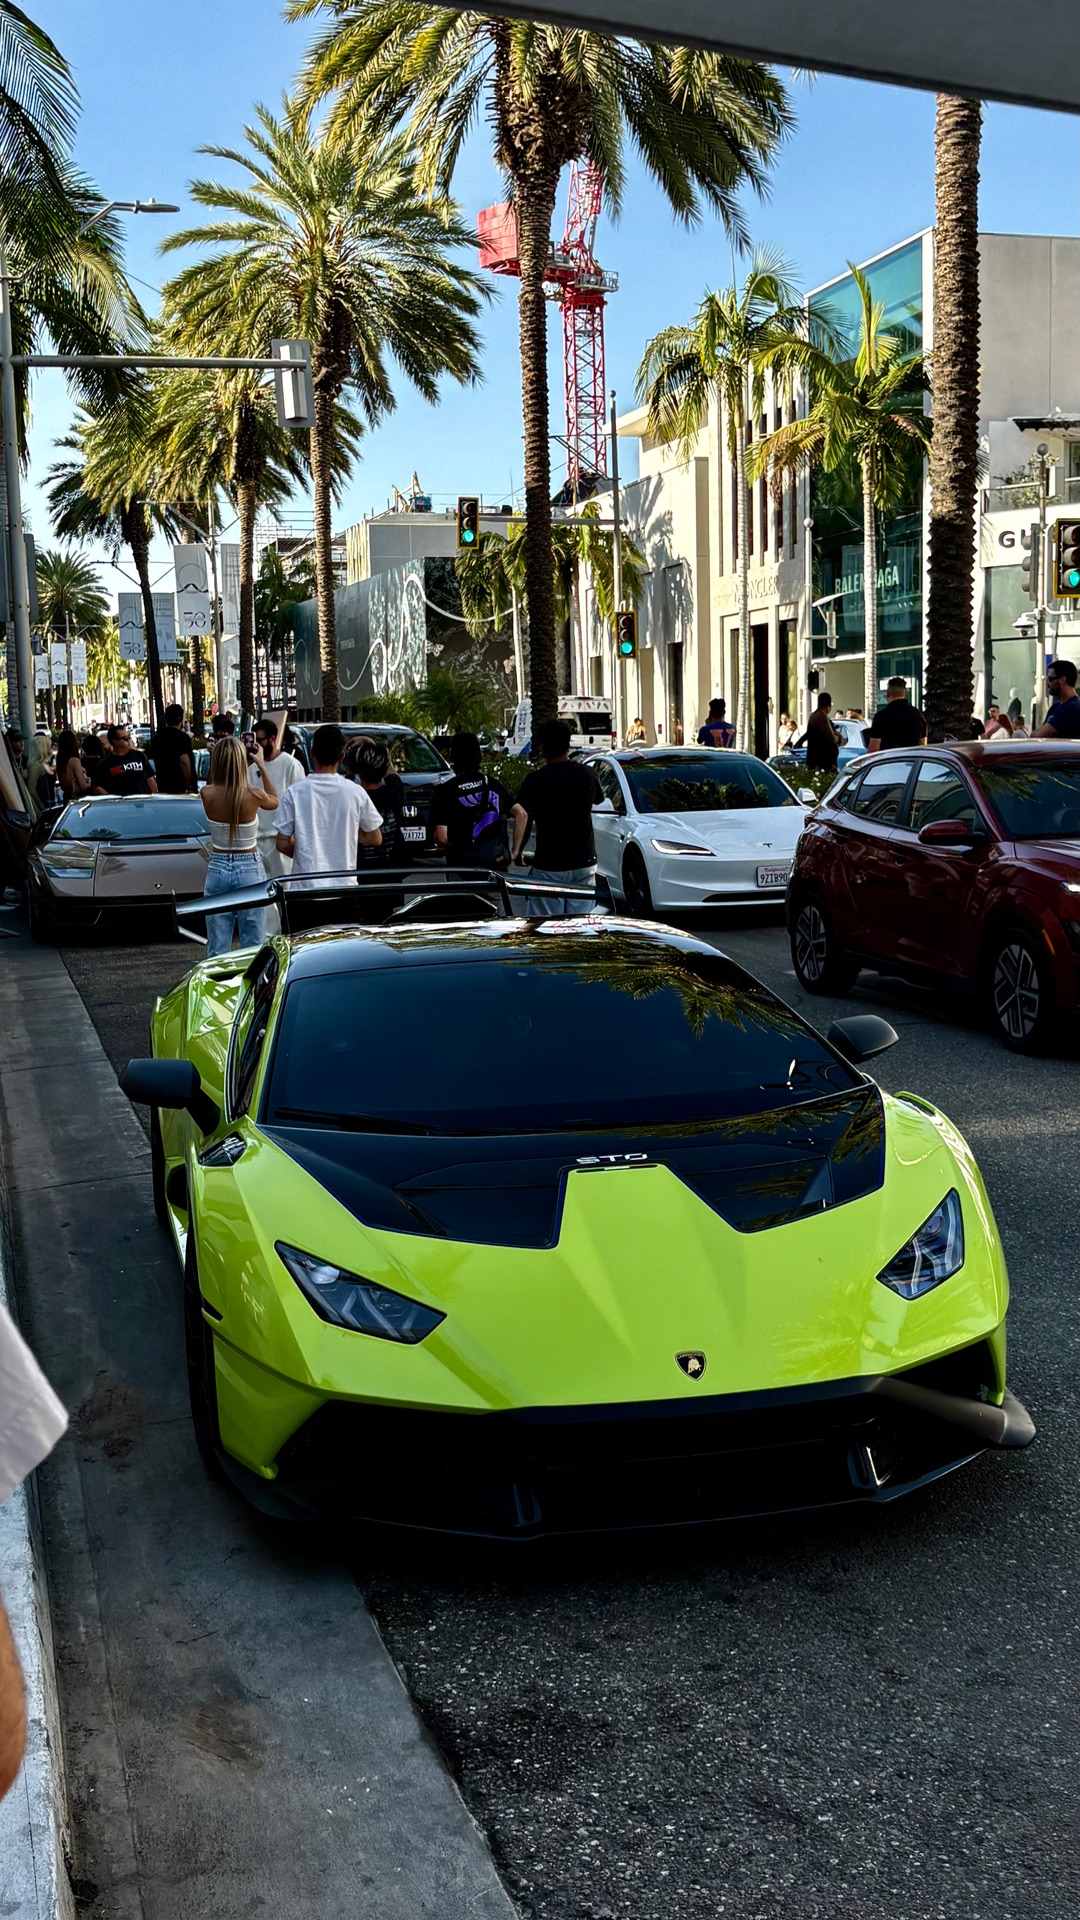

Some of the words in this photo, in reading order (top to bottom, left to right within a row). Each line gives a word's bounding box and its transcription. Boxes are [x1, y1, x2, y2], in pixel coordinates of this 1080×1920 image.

[183, 610, 207, 629] 50
[123, 641, 142, 655] 50
[123, 761, 144, 771] KITH
[760, 871, 790, 884] 9ZIB90
[576, 1152, 648, 1165] STO
